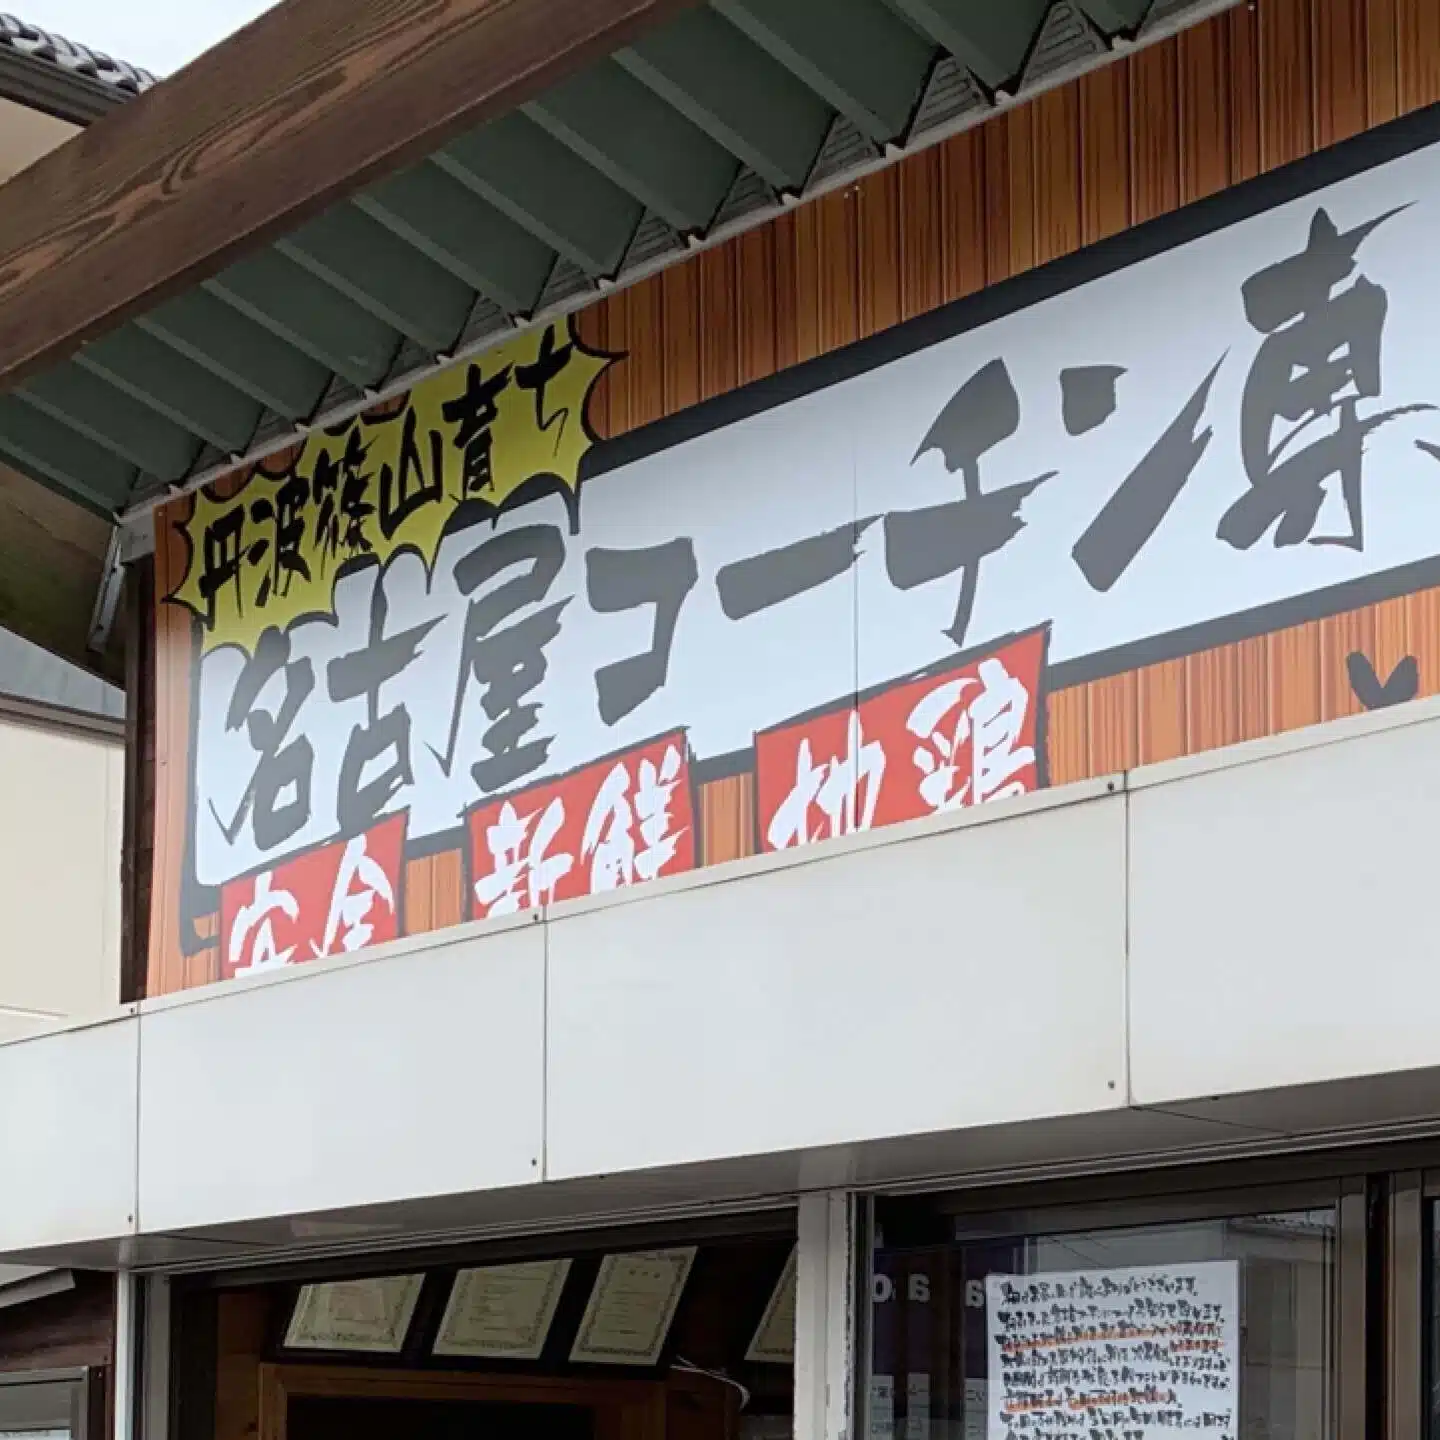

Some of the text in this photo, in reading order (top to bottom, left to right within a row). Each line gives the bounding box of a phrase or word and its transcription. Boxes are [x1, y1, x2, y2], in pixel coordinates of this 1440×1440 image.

[199, 323, 574, 619] 丹波篠山育ち
